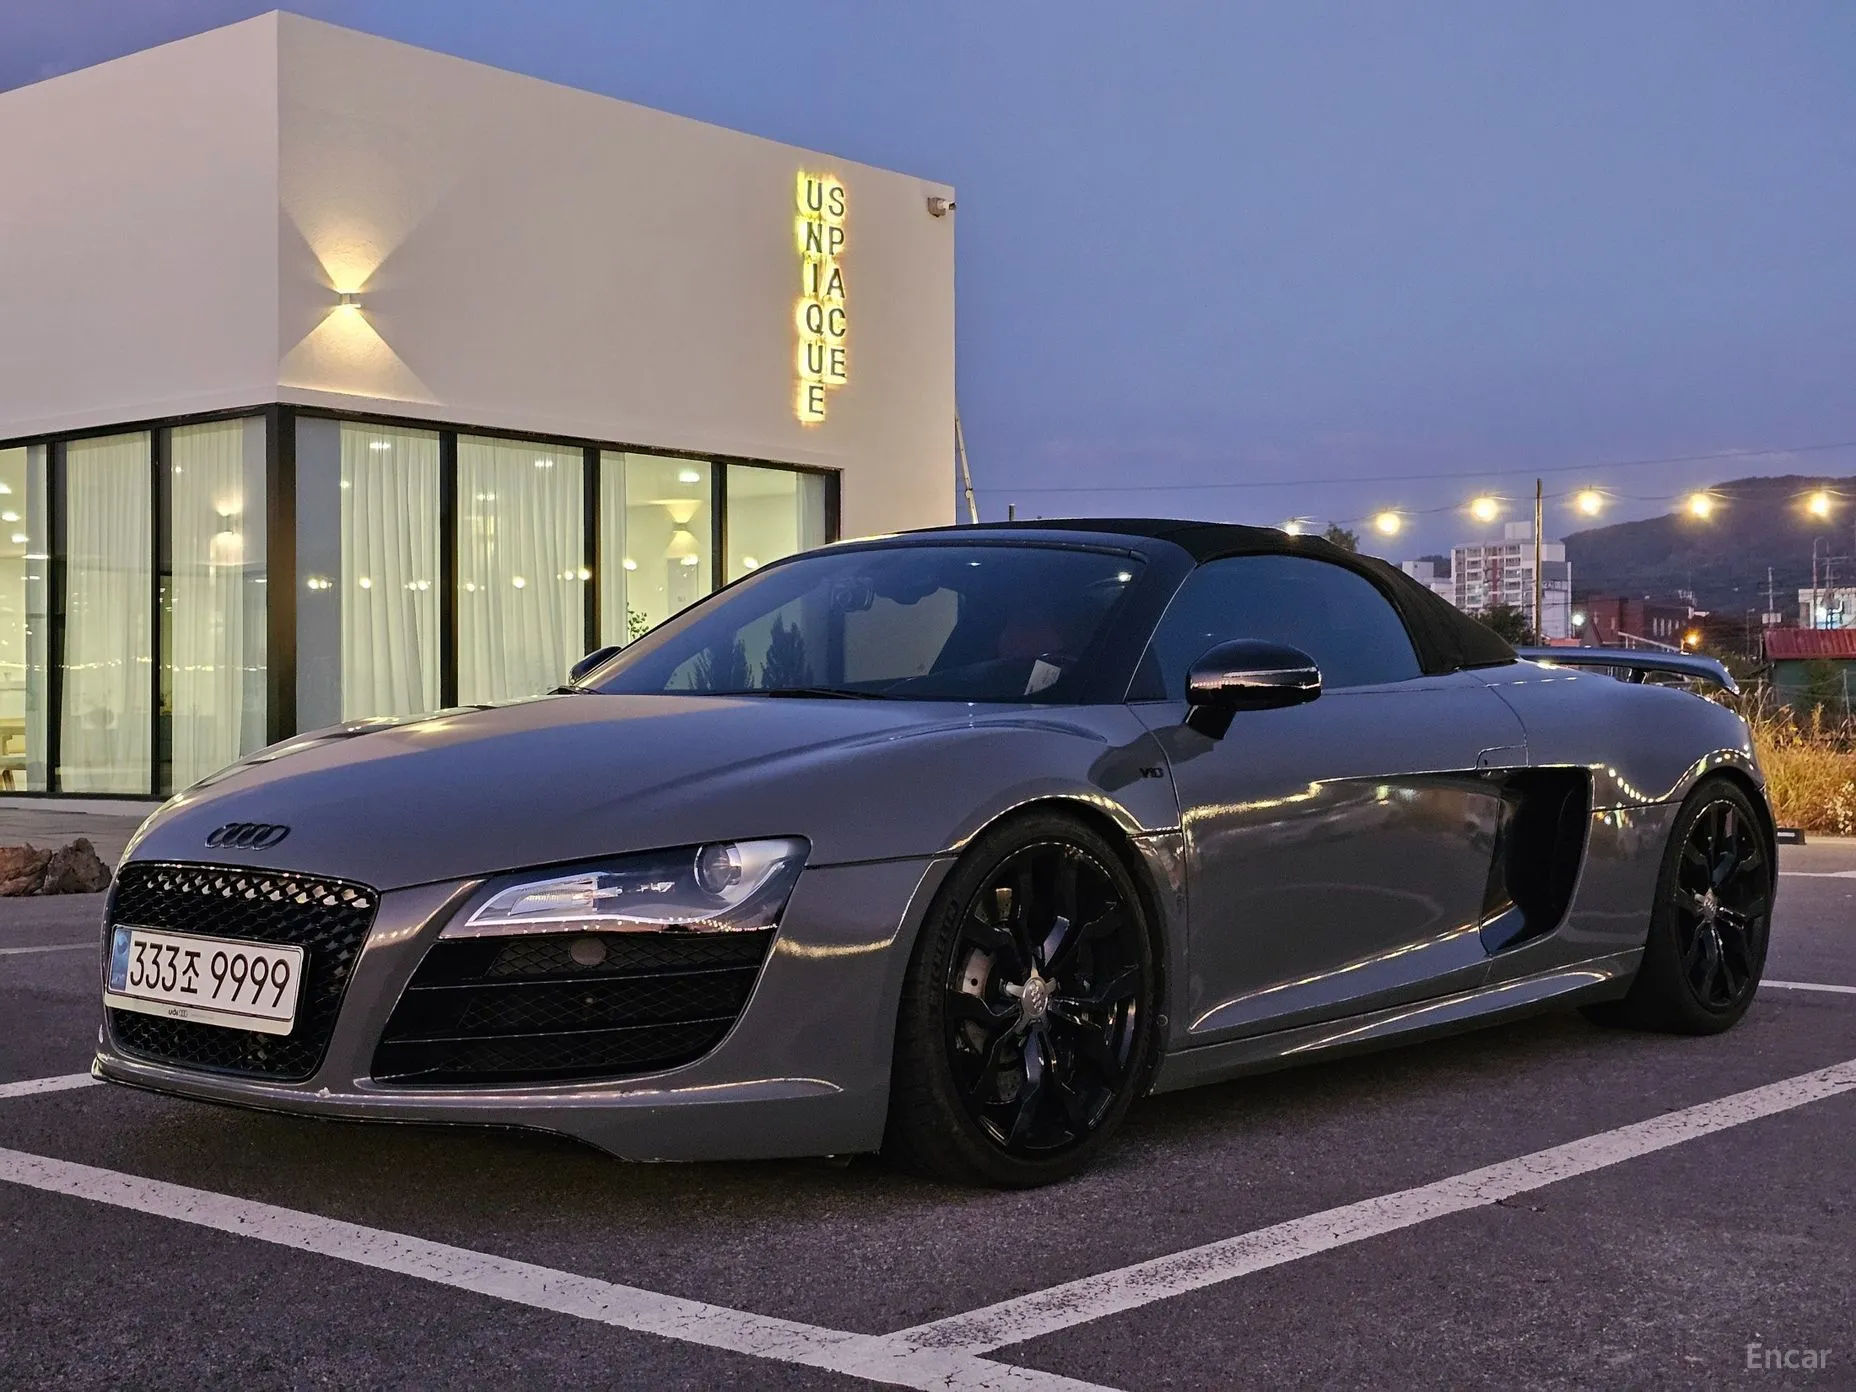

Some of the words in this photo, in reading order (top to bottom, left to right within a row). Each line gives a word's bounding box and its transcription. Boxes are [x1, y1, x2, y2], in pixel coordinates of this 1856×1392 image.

[806, 180, 824, 415] UNIQUE
[827, 187, 846, 378] SPACE
[130, 941, 201, 994] 333조
[211, 951, 290, 1008] 9999
